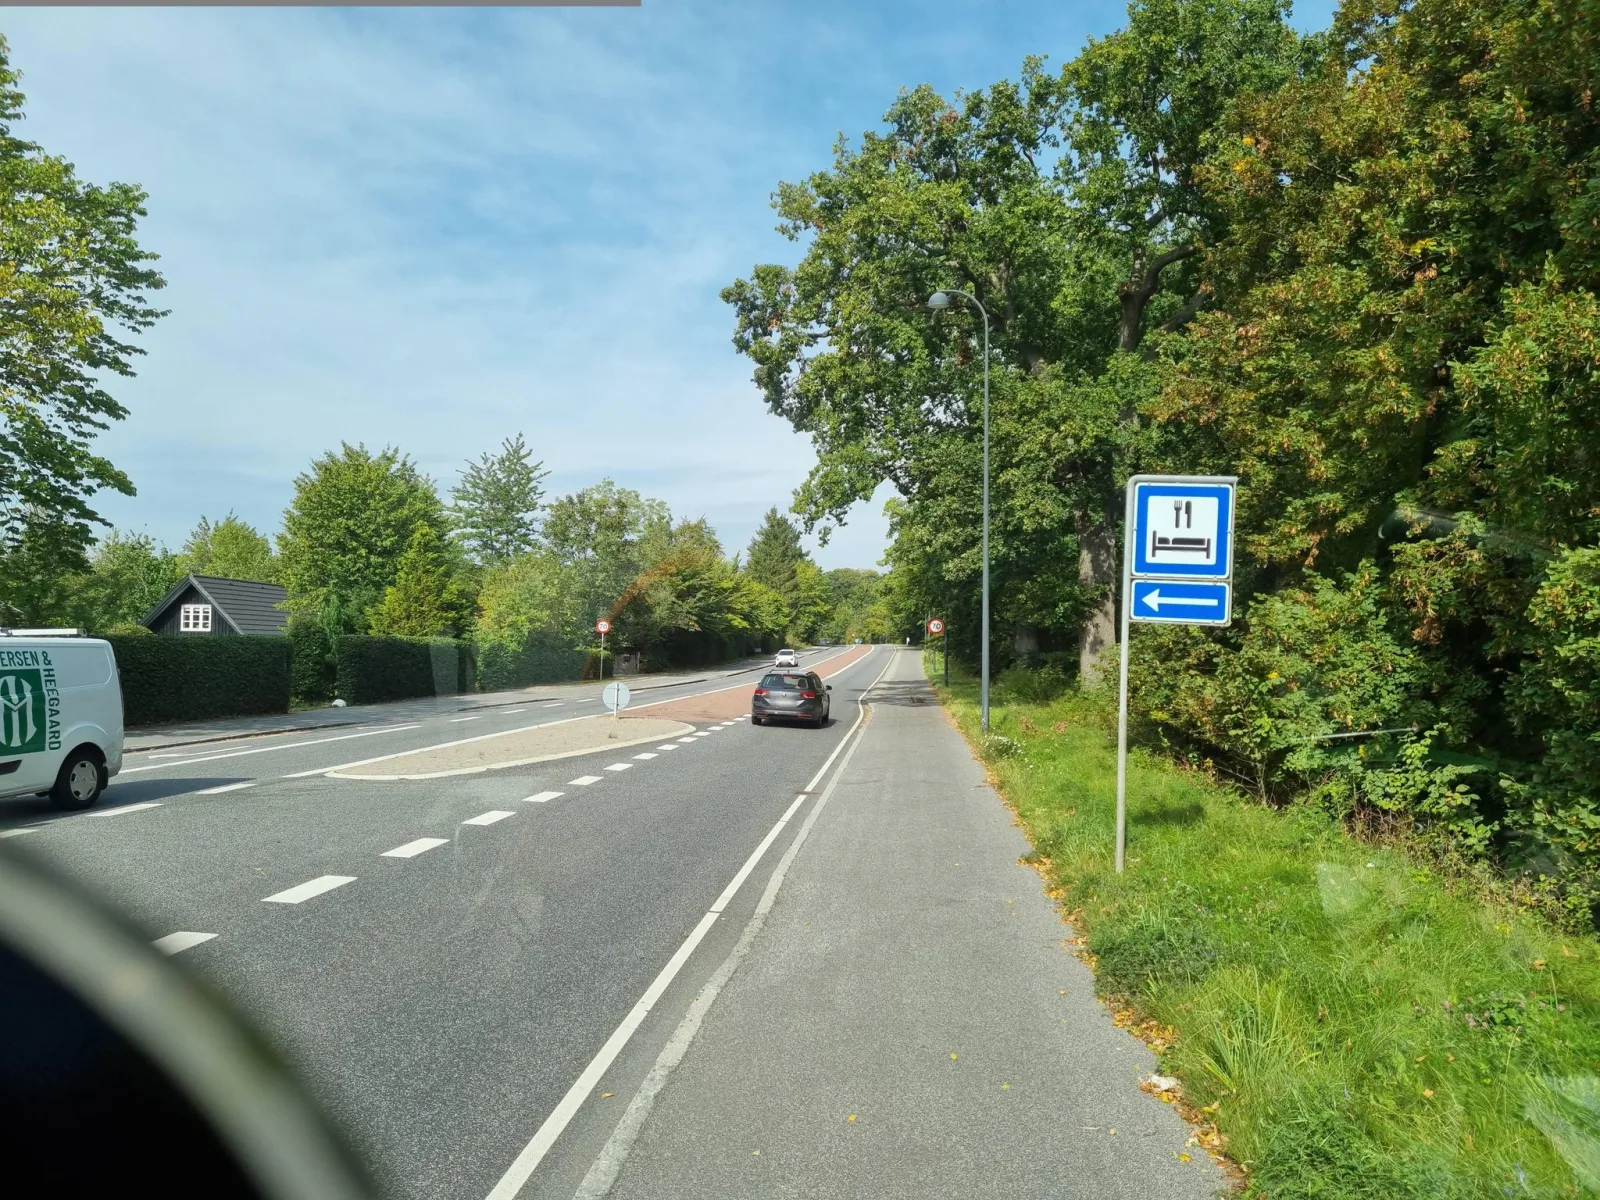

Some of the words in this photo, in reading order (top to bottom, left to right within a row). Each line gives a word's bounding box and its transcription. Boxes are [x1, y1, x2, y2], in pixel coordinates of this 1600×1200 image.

[932, 622, 941, 630] 70
[0, 650, 40, 667] ERSEN
[41, 650, 53, 666] &
[42, 668, 62, 751] HEEGAARD
